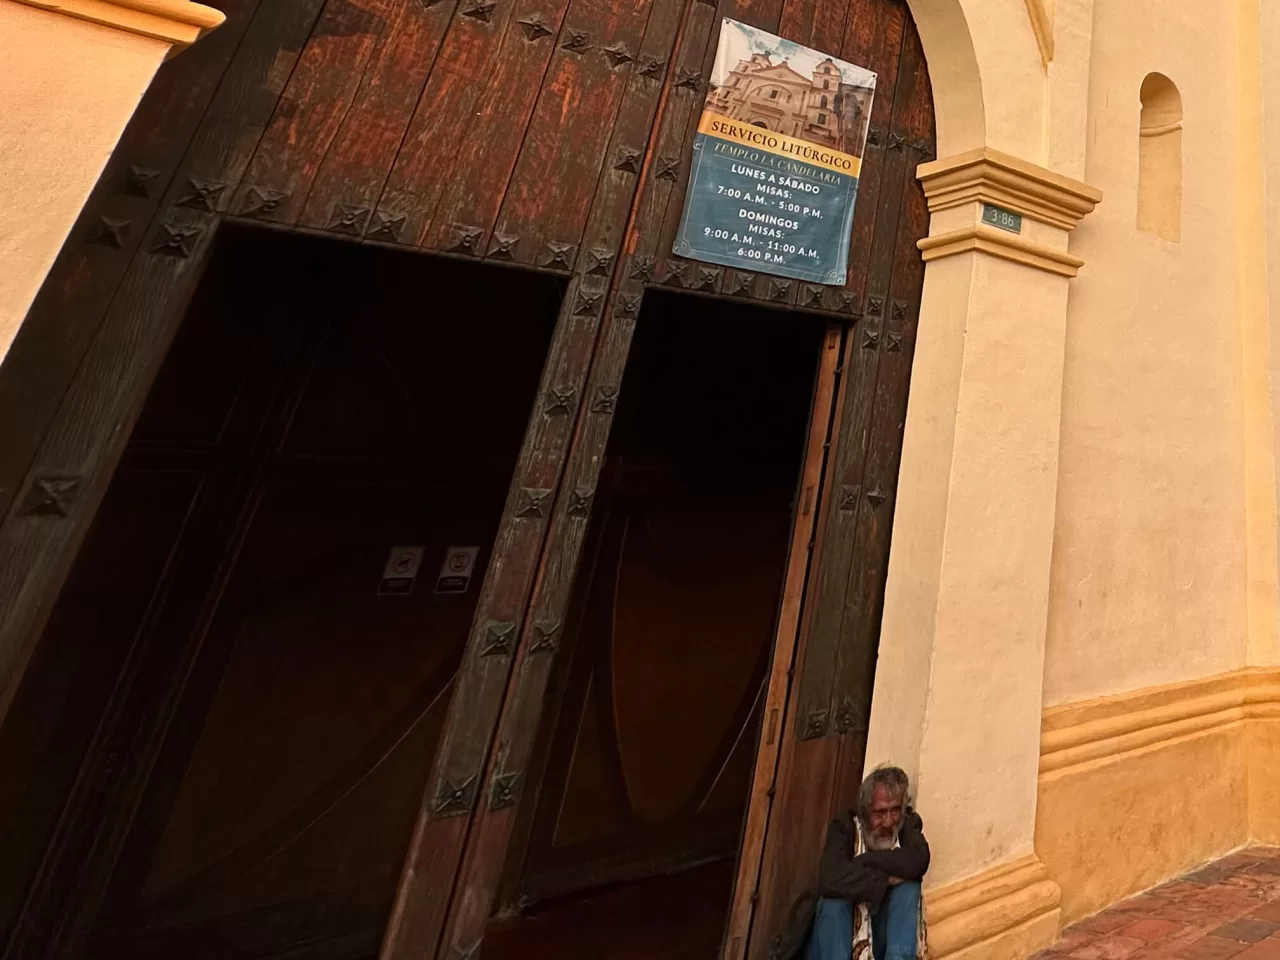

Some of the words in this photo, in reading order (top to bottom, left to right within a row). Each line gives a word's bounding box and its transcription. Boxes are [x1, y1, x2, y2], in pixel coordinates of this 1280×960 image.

[711, 121, 778, 148] SERVICIO
[781, 141, 851, 170] LITÚRGICO
[714, 142, 759, 161] TEMPLO
[760, 156, 775, 166] LA
[777, 159, 841, 185] CANDELARIA
[731, 163, 766, 180] LUNES
[767, 174, 776, 184] A
[778, 176, 820, 194] SÁBADO
[717, 185, 741, 199] 7:00
[743, 193, 768, 206] A.M.
[778, 201, 800, 213] 5:00
[802, 207, 824, 219] P.M.
[756, 183, 793, 199] MISAS:
[738, 208, 799, 230] DOMINGOS
[748, 224, 786, 239] MISAS:
[704, 227, 729, 240] 9:00
[731, 233, 756, 246] A.M.
[767, 240, 796, 254] 11:00
[798, 247, 820, 259] A.M.
[737, 247, 761, 259] 6:00
[764, 252, 787, 264] P.M.
